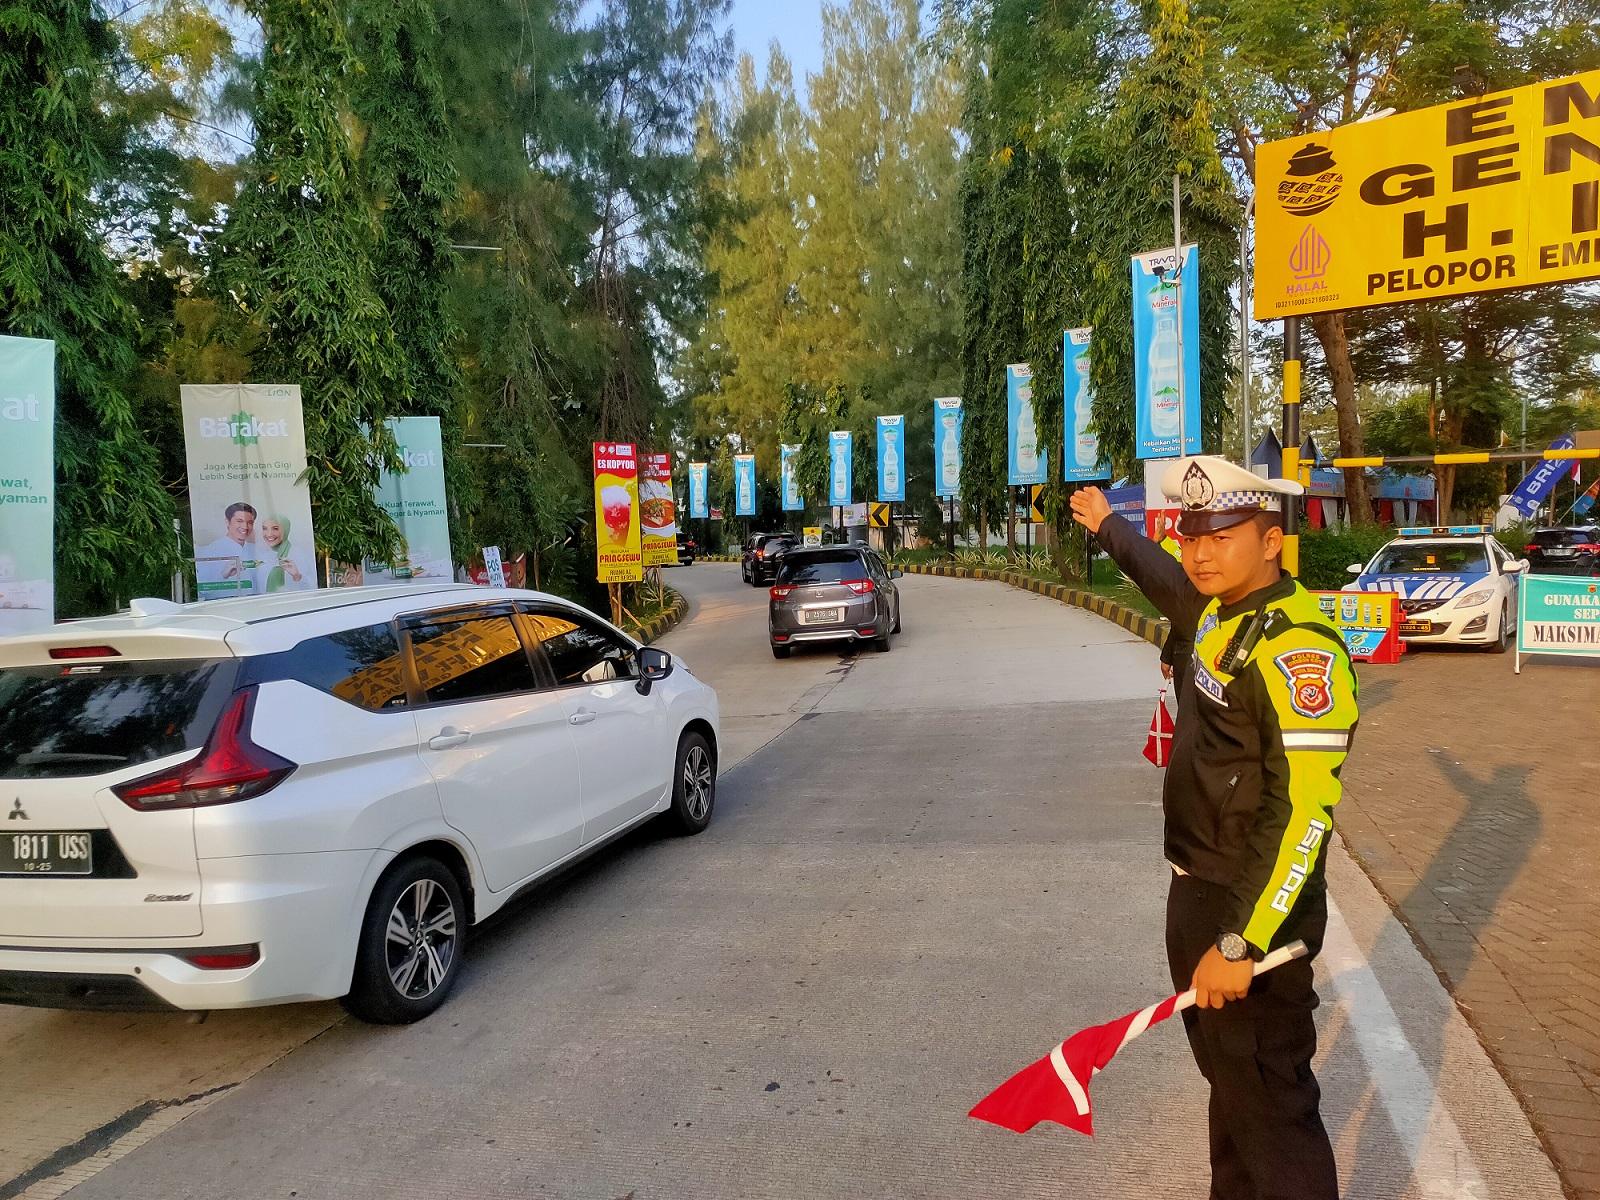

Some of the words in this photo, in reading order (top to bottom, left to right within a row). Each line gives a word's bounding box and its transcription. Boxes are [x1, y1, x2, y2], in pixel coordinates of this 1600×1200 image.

[1367, 254, 1516, 296] PELOPOR
[1286, 280, 1328, 294] HALAL
[266, 388, 292, 397] LION
[203, 463, 226, 471] Jaga
[227, 462, 272, 470] Kesehatan
[274, 460, 292, 470] Gigi
[226, 473, 252, 481] Segar
[414, 508, 445, 517] Nyaman
[599, 553, 641, 564] PRINGSEWU
[1197, 670, 1220, 697] POLRI
[12, 834, 49, 860] 1811
[59, 834, 88, 860] USS
[1270, 817, 1327, 915] POLISI
